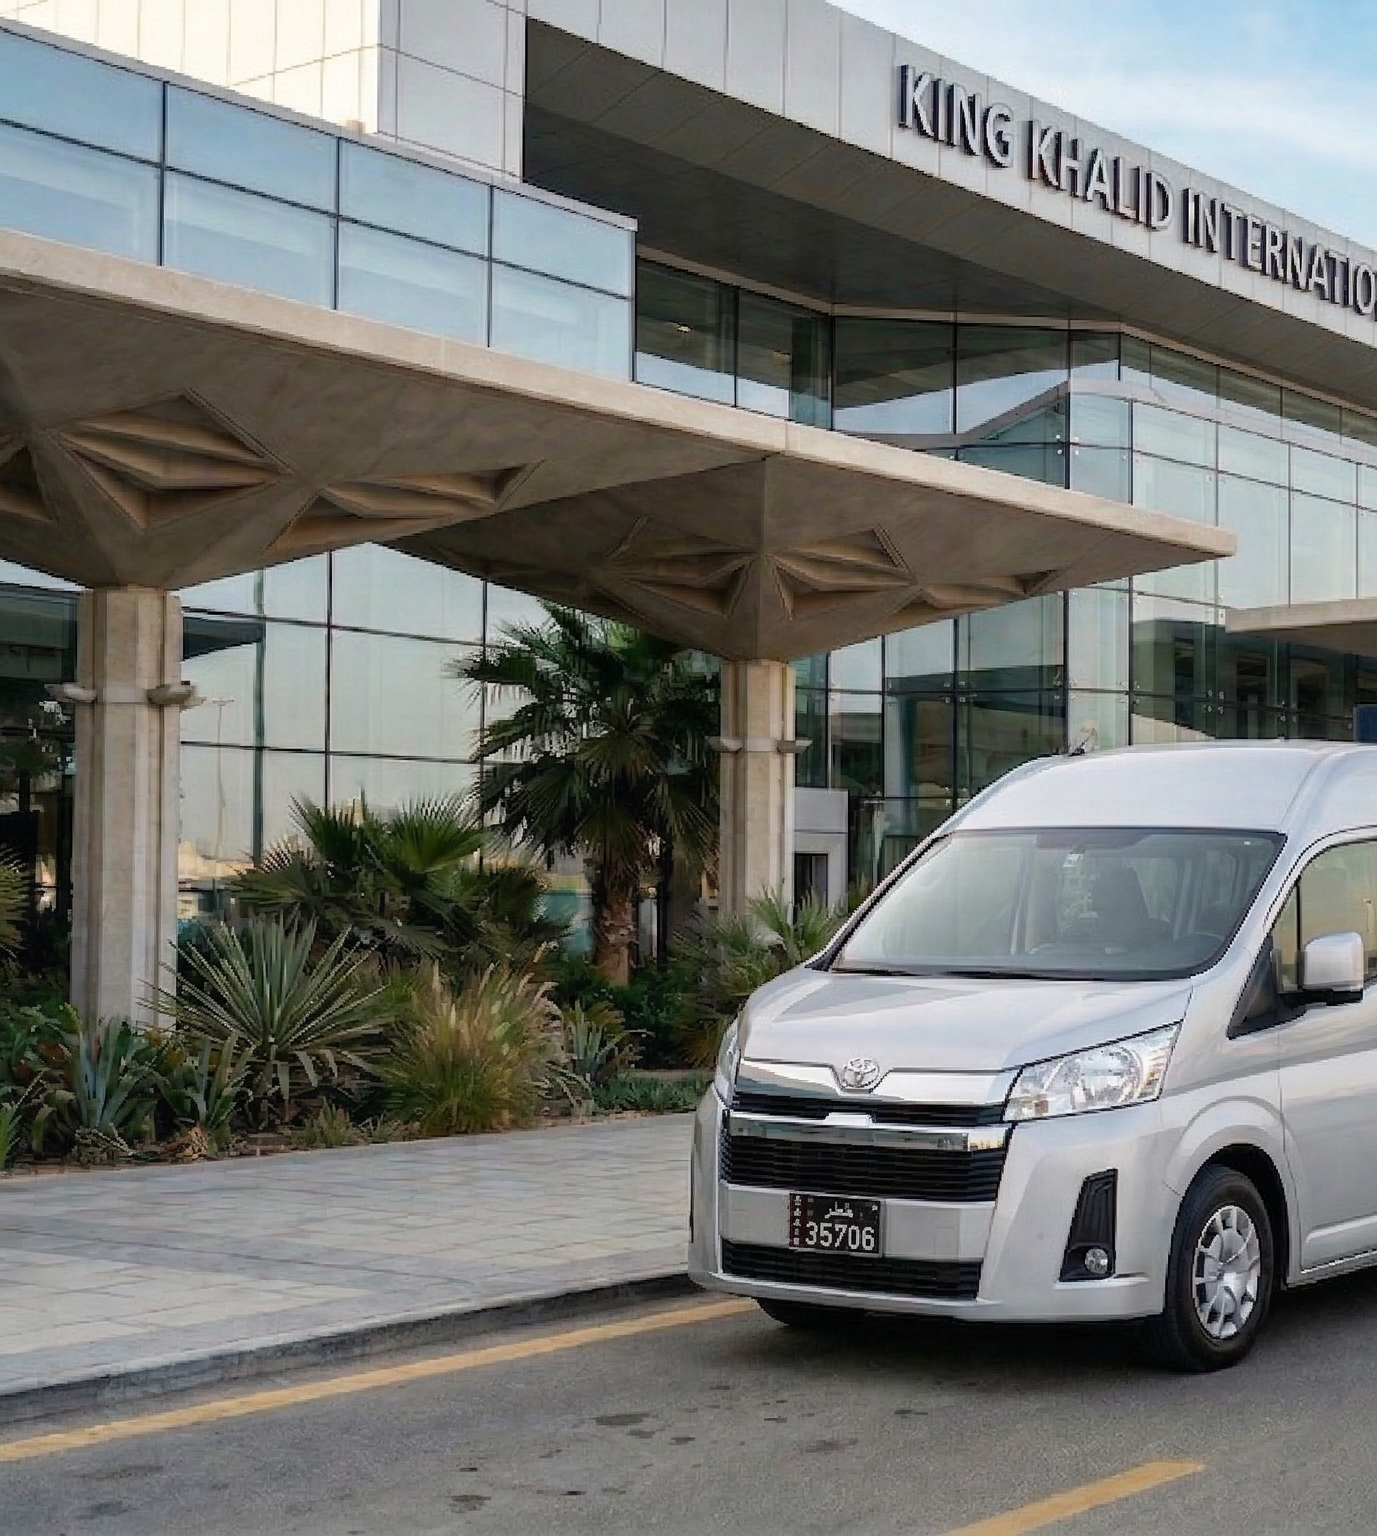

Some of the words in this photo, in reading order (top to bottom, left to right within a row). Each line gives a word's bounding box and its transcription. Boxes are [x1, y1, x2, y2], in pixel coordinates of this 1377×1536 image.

[899, 64, 1014, 168] KING
[1026, 119, 1173, 232] KHALID
[805, 1221, 875, 1251] 35706
